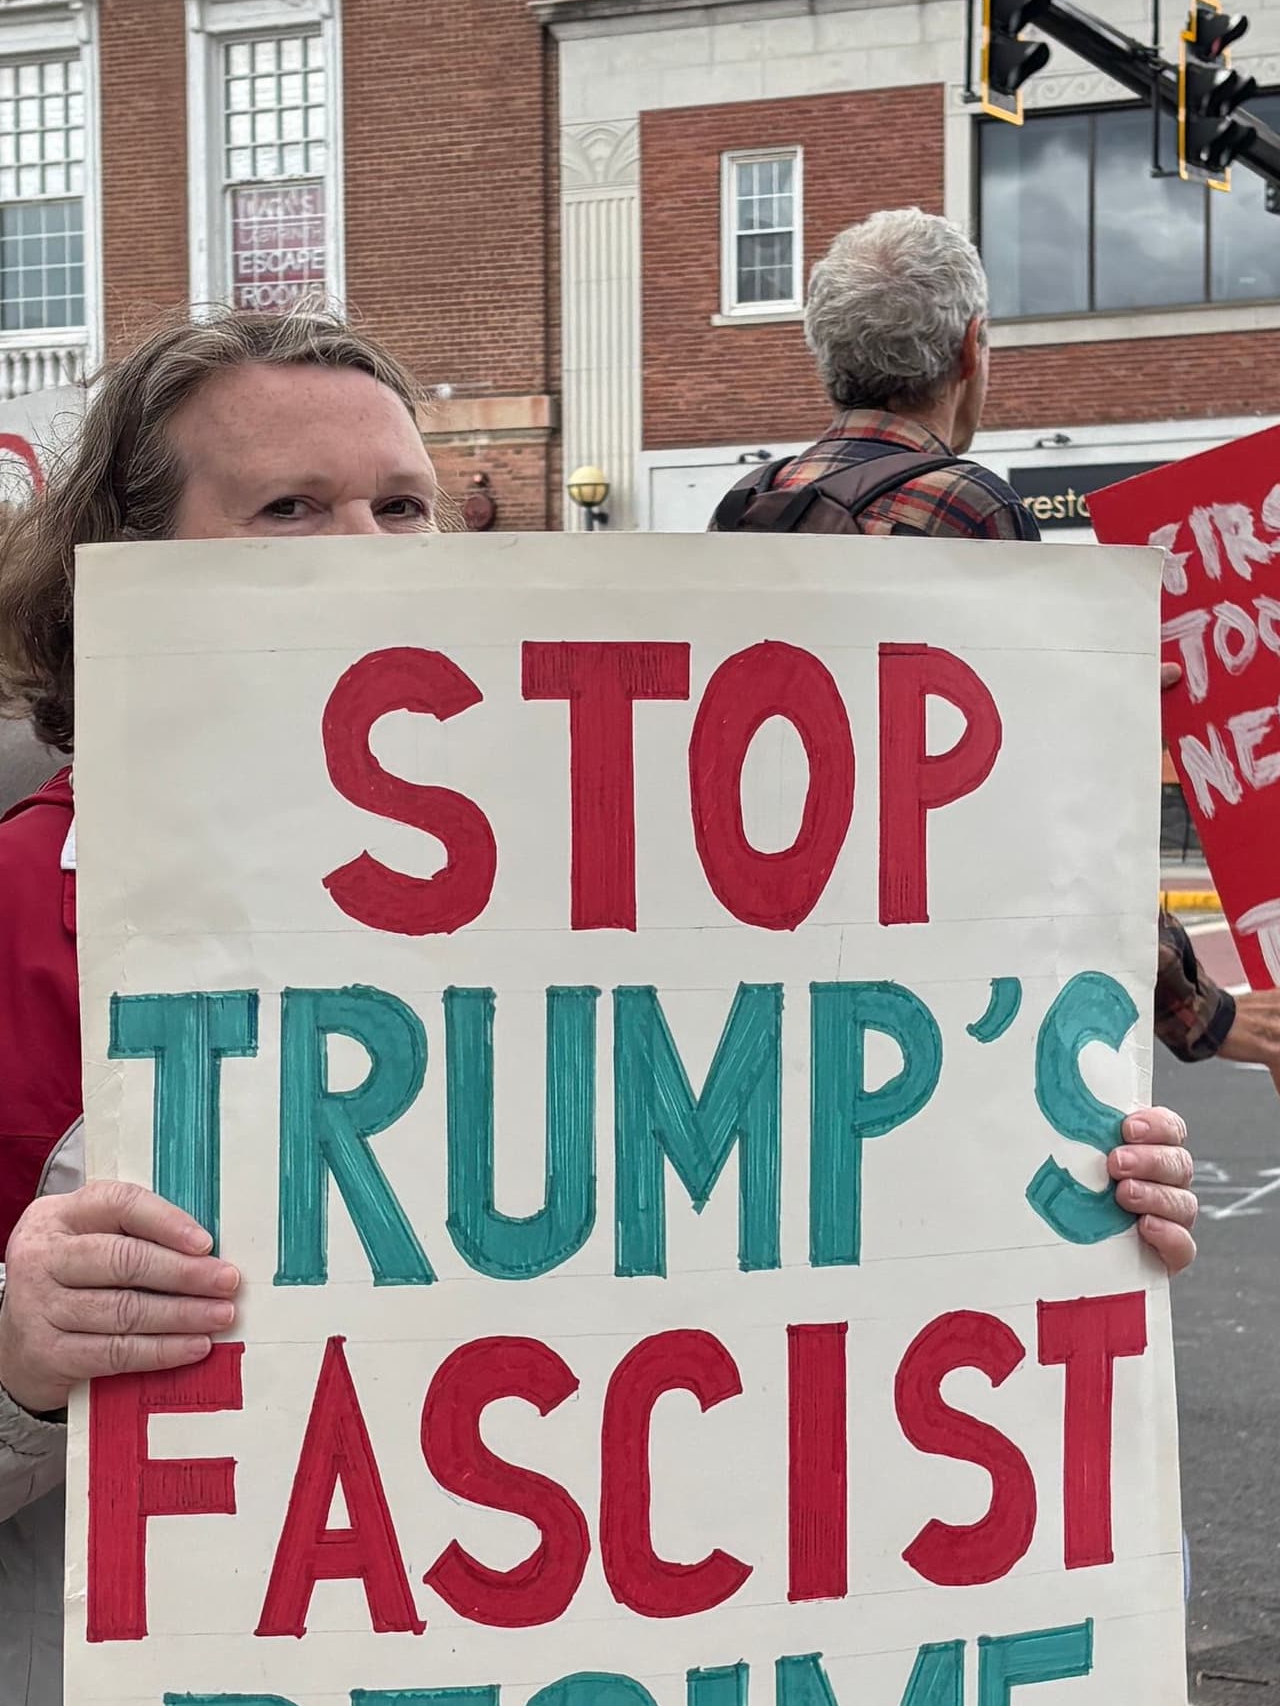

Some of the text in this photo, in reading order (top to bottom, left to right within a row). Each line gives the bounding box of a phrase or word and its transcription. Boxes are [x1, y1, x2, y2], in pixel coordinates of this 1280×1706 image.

[238, 248, 326, 274] ESCAPE
[320, 639, 1003, 936] STOP
[107, 970, 1139, 1285] TRUMP'S
[86, 1290, 1148, 1643] FASCIST
